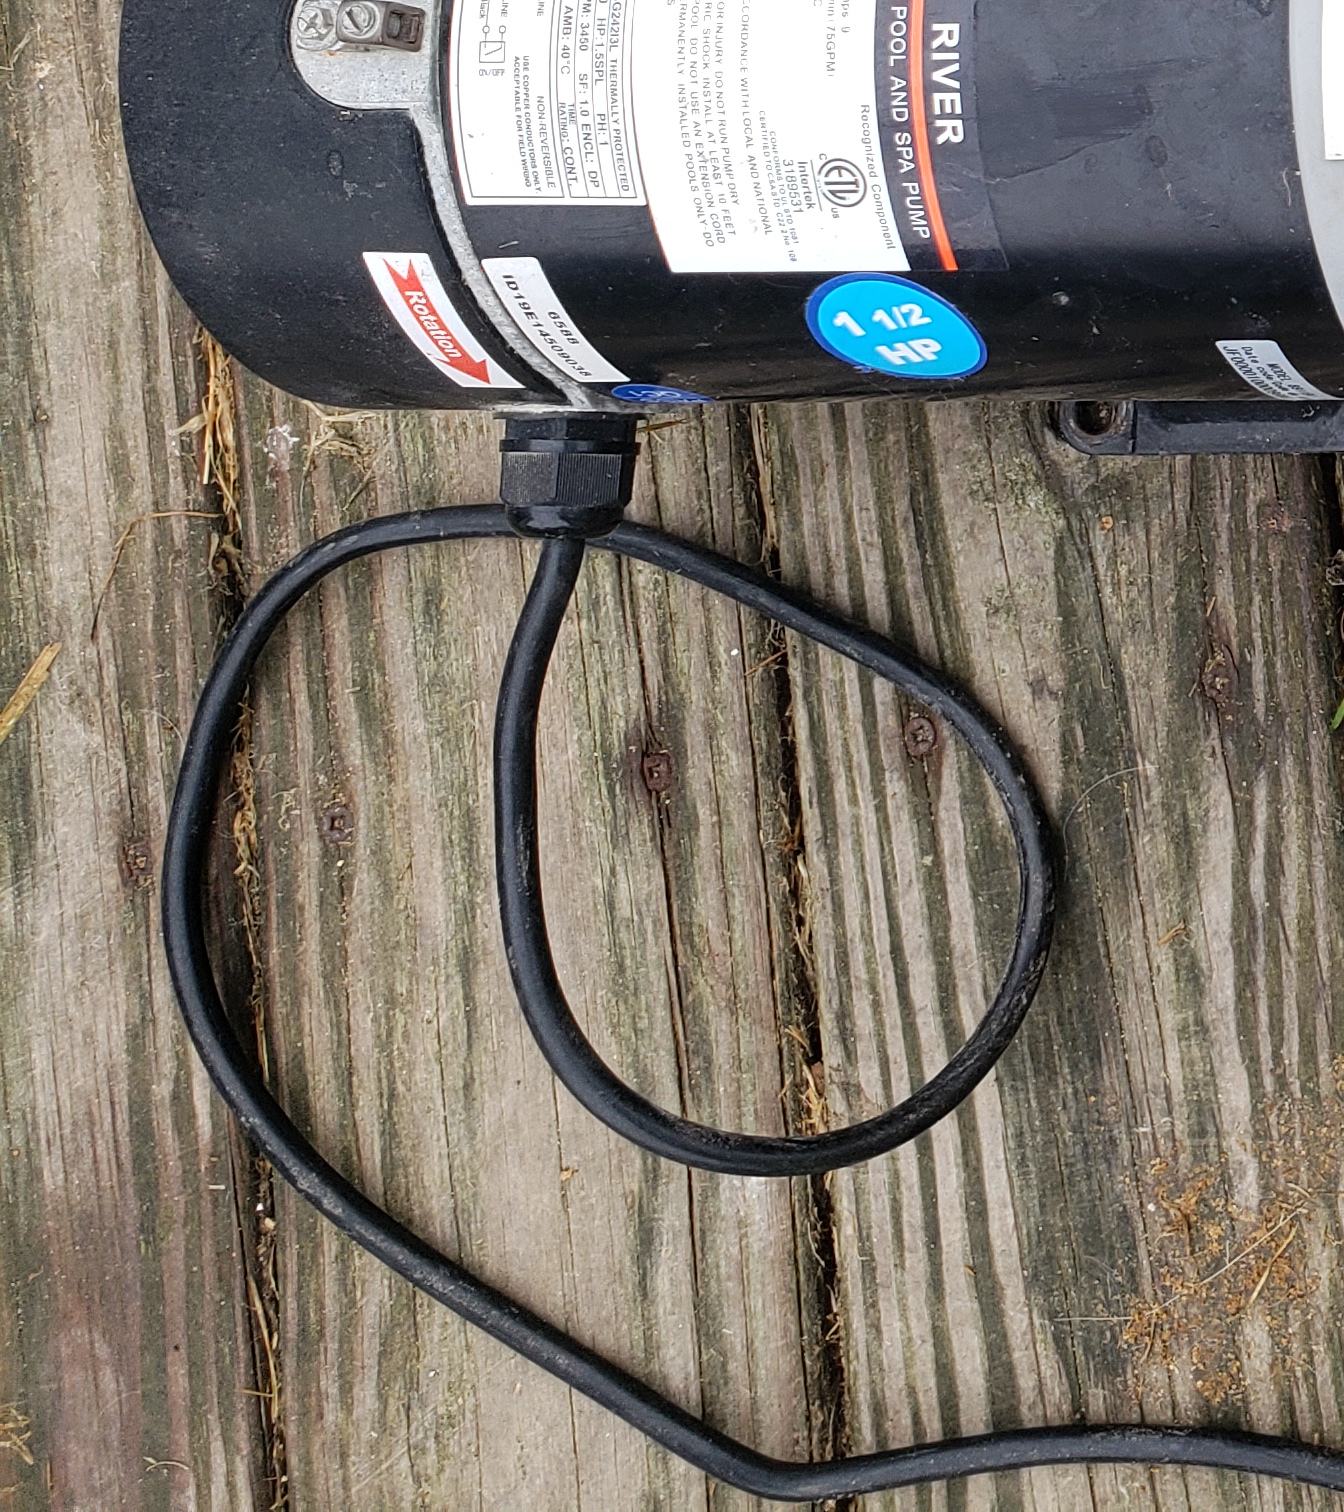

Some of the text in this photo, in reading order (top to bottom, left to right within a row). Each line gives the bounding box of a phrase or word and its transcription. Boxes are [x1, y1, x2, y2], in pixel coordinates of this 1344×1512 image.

[561, 5, 573, 40] AMB:
[716, 1, 725, 19] OR
[578, 22, 589, 51] 3450
[689, 37, 698, 54] DO
[714, 22, 723, 64] INJURY
[889, 6, 907, 66] POOL
[559, 43, 571, 74] 40°C
[689, 60, 698, 84] NOT
[578, 72, 587, 94] SF:
[609, 57, 619, 124] THERMALLY
[714, 71, 723, 88] DO
[740, 77, 749, 108] WITH
[930, 22, 964, 144] RIVER
[567, 103, 576, 125] TIME
[578, 99, 589, 116] 1.0
[689, 91, 699, 115] USE
[702, 77, 712, 125] INSTALL
[715, 91, 725, 115] NOT
[889, 75, 908, 122] AND
[536, 95, 555, 188] NON-REVERSIBLE
[596, 113, 607, 136] PH:
[677, 83, 690, 147] INSTALLED
[684, 153, 699, 192] POOLS
[692, 120, 702, 136] AN
[706, 131, 716, 144] AT
[717, 119, 728, 143] RUN
[741, 111, 754, 148] LOCAL
[580, 123, 594, 163] ENCL:
[612, 128, 629, 191] PROTECTED
[894, 132, 915, 173] SPA
[563, 146, 578, 186] CONT.
[587, 170, 599, 188] DP
[694, 142, 715, 207] EXTENSION
[708, 150, 722, 186] LEAST
[720, 147, 734, 179] PUMP
[747, 154, 759, 178] AND
[860, 104, 896, 249] Recognized Component
[727, 182, 739, 205] DRY
[782, 159, 804, 213] 3189531
[797, 161, 815, 209] Intertek
[720, 209, 736, 235] FEET
[752, 181, 772, 235] NATIONAL
[901, 182, 930, 238] PUMP
[401, 290, 464, 358] Rotation
[545, 309, 581, 347] 6588
[832, 302, 932, 337] 1 1/2
[874, 337, 942, 365] HP
